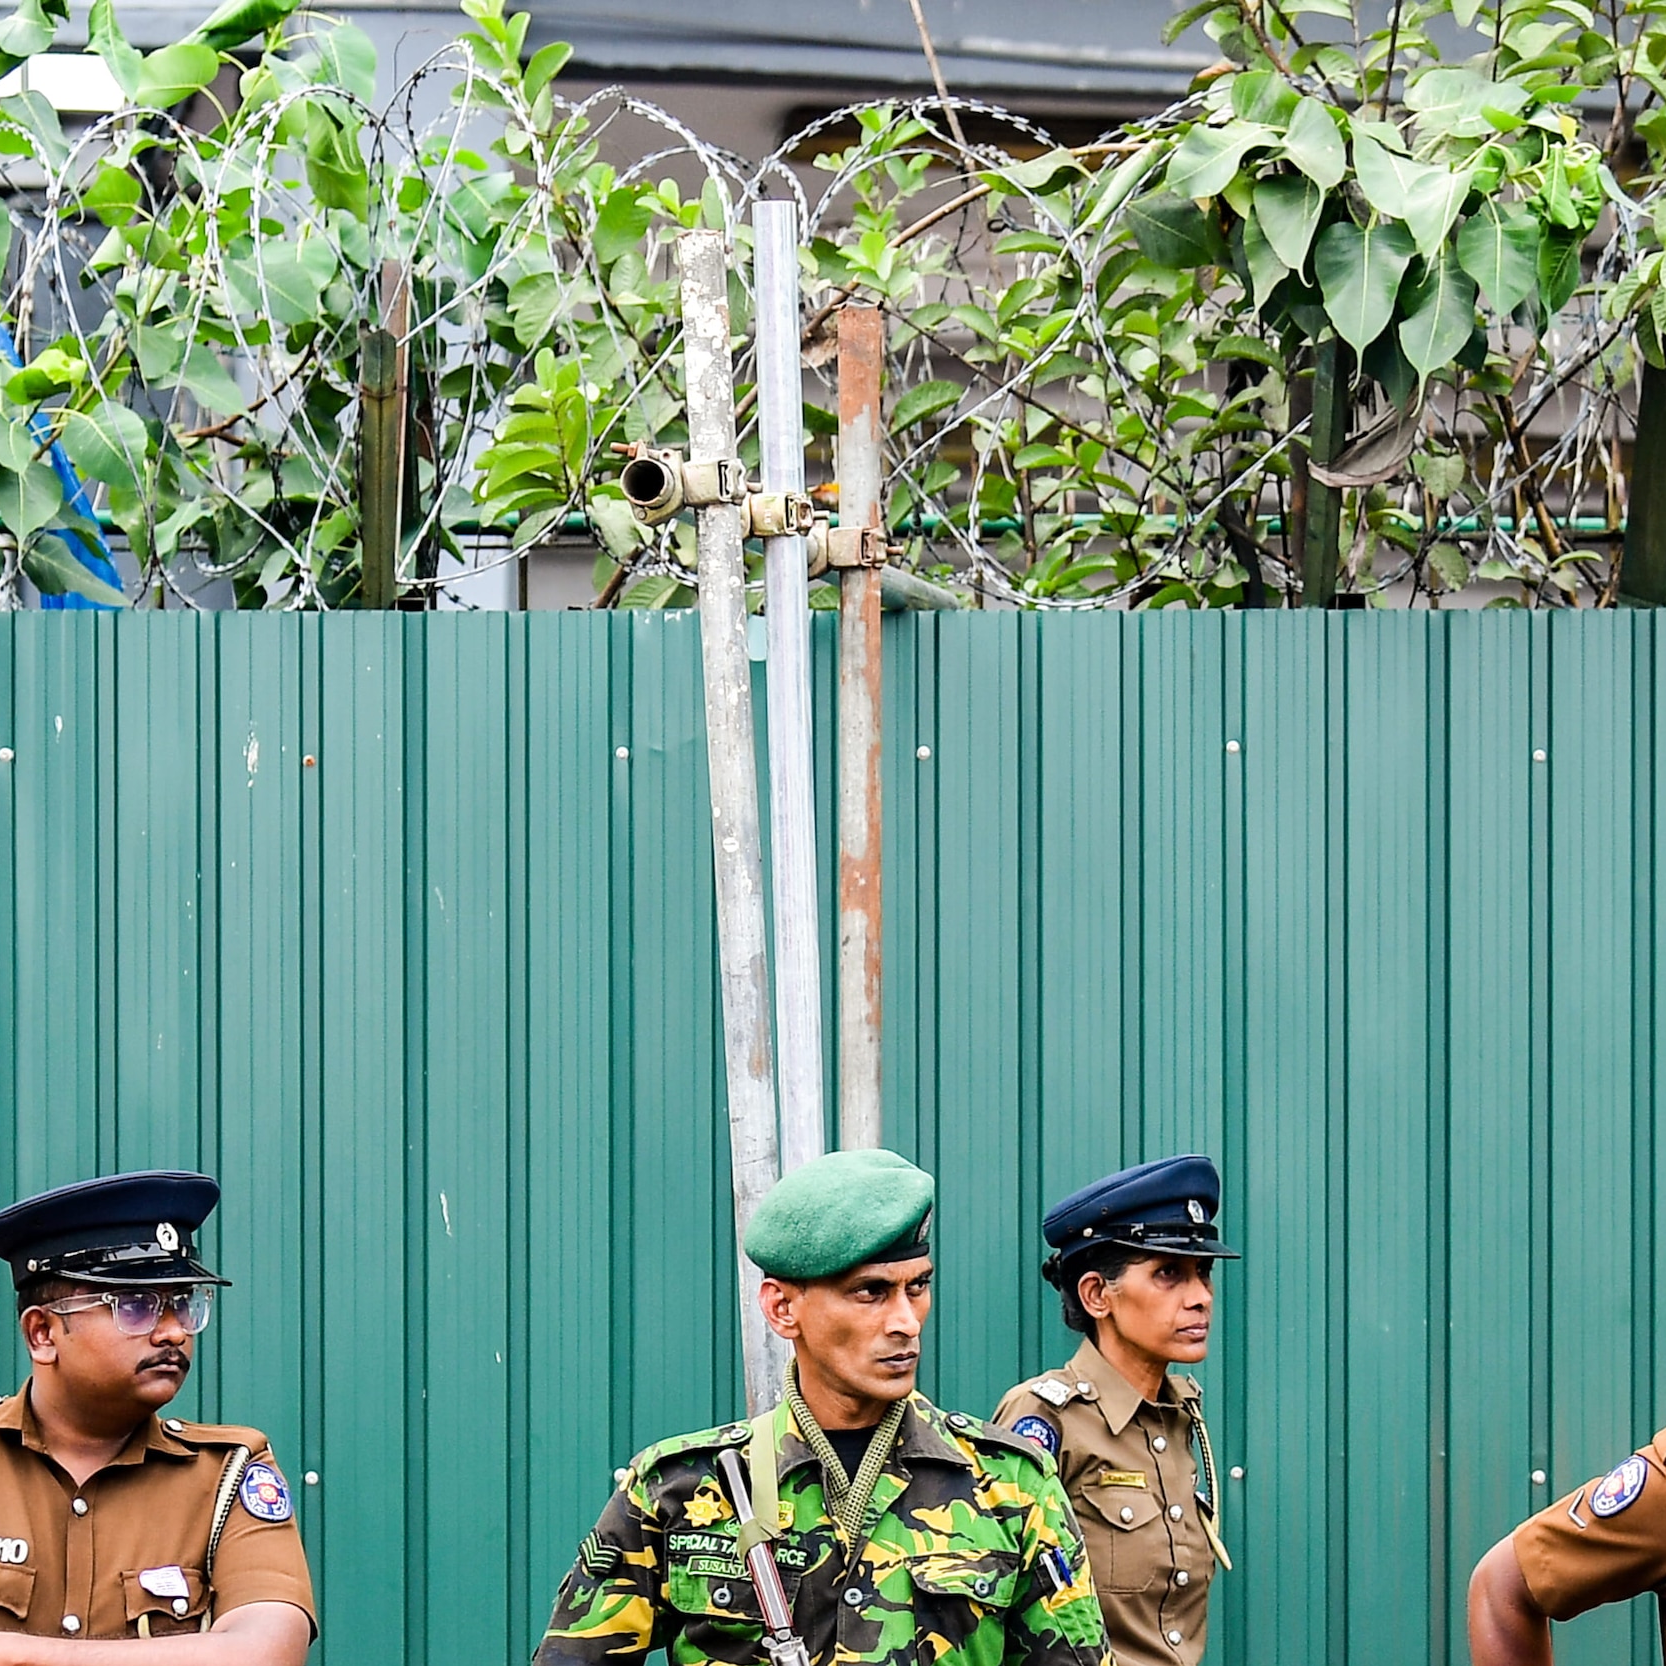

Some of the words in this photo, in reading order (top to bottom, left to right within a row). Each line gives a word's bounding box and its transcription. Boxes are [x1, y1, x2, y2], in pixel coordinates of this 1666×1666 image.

[668, 1533, 719, 1553] SPECIAL
[721, 1539, 738, 1555] TA
[776, 1548, 808, 1567] RCE
